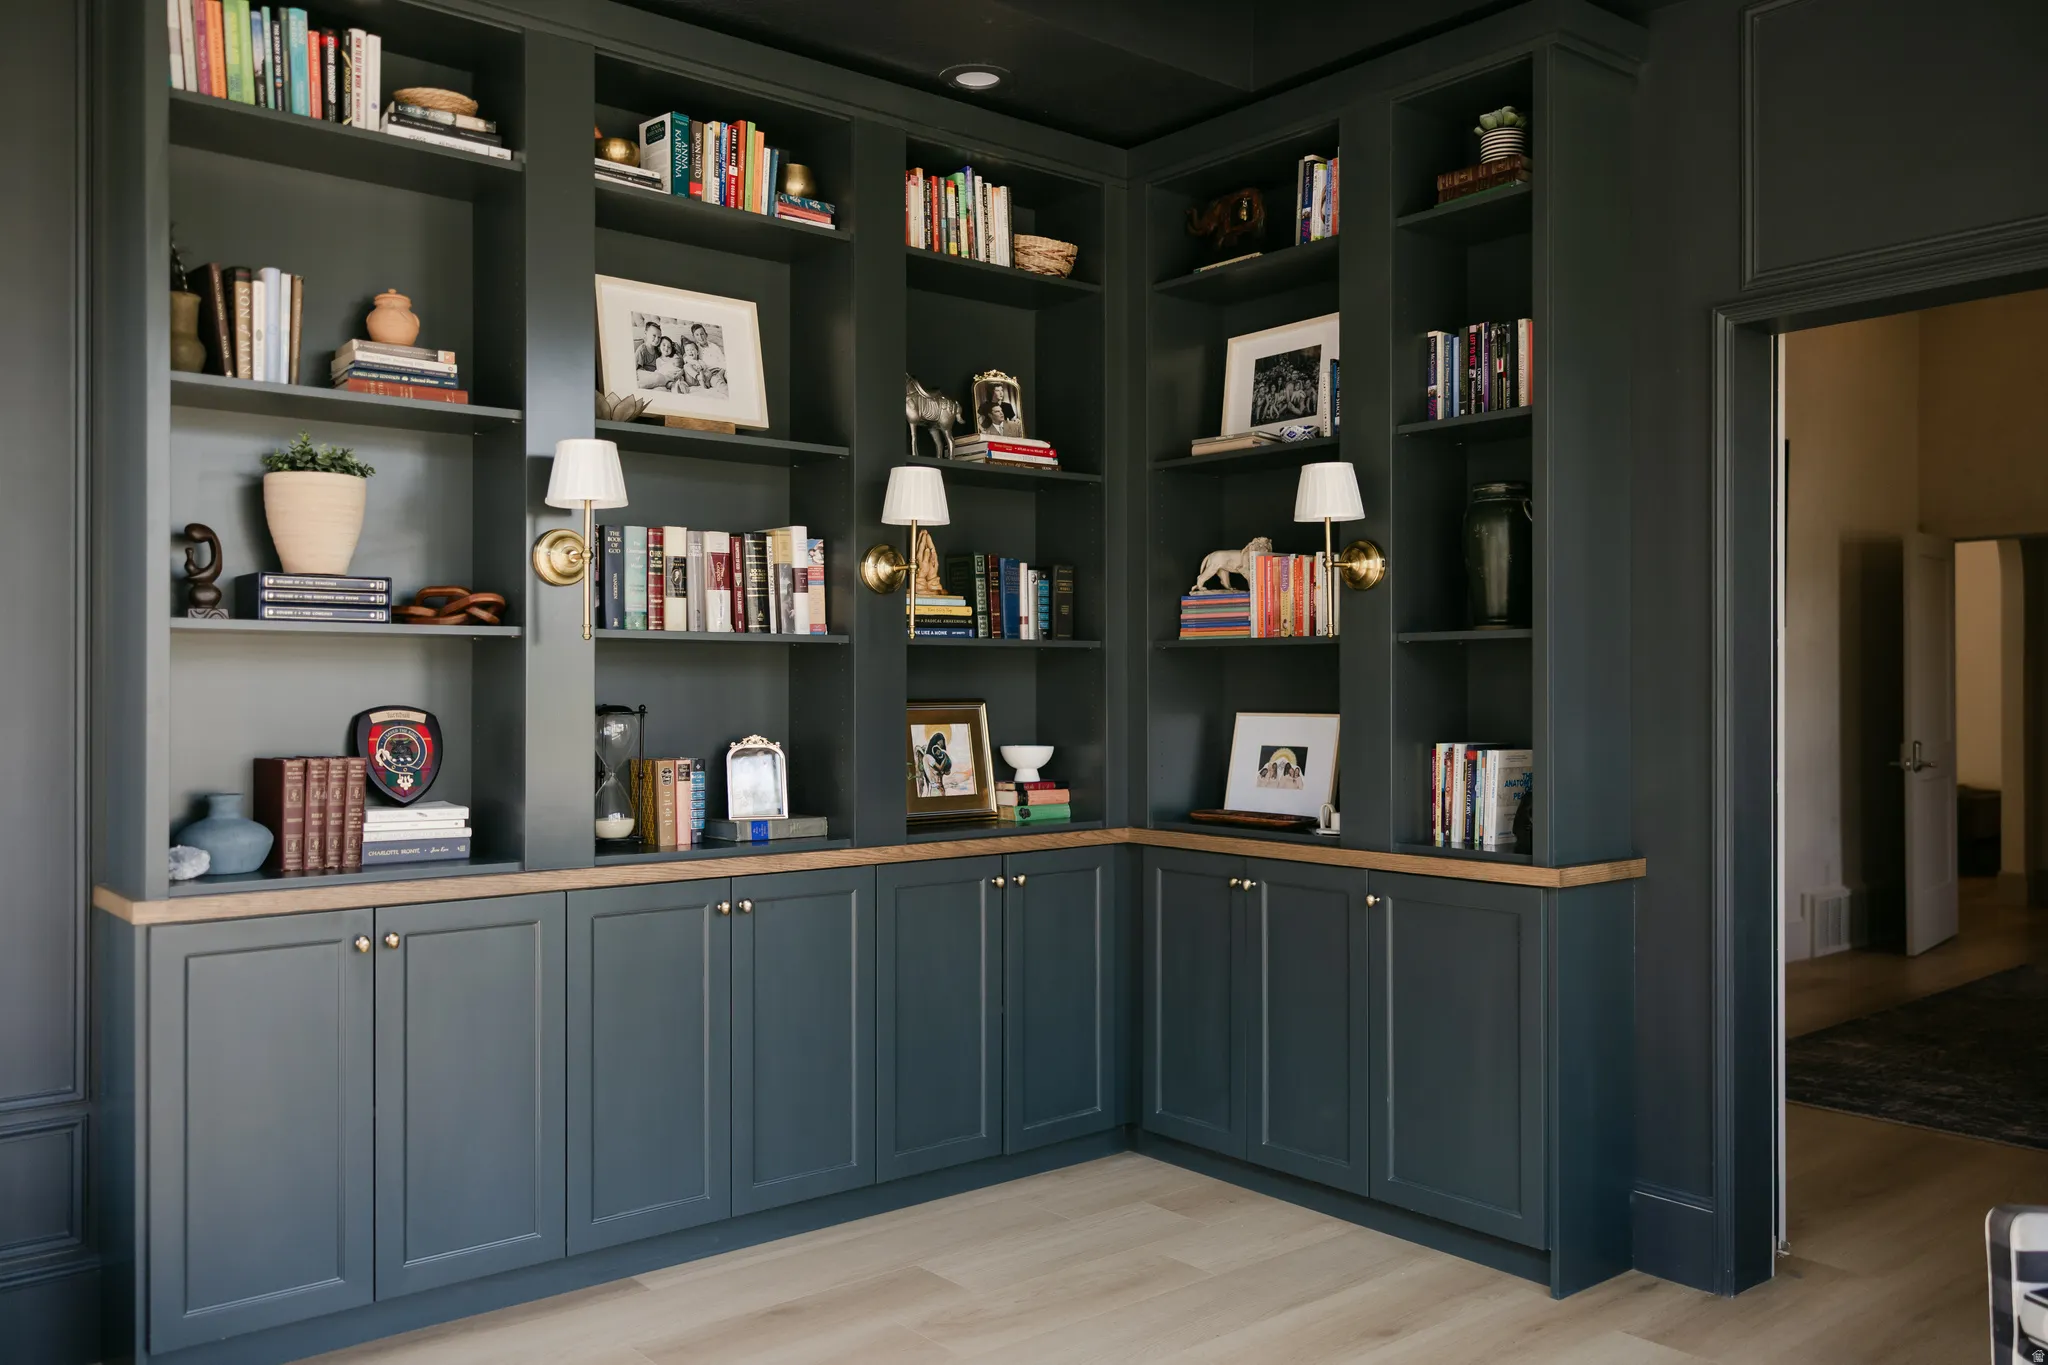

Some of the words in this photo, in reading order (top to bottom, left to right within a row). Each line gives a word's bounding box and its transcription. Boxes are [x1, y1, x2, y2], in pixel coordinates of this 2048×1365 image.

[328, 65, 336, 104] OWNERSHIP
[239, 288, 250, 318] SON
[239, 324, 250, 336] of
[240, 341, 250, 375] MAN
[386, 729, 399, 738] SAVED
[408, 730, 418, 740] KING
